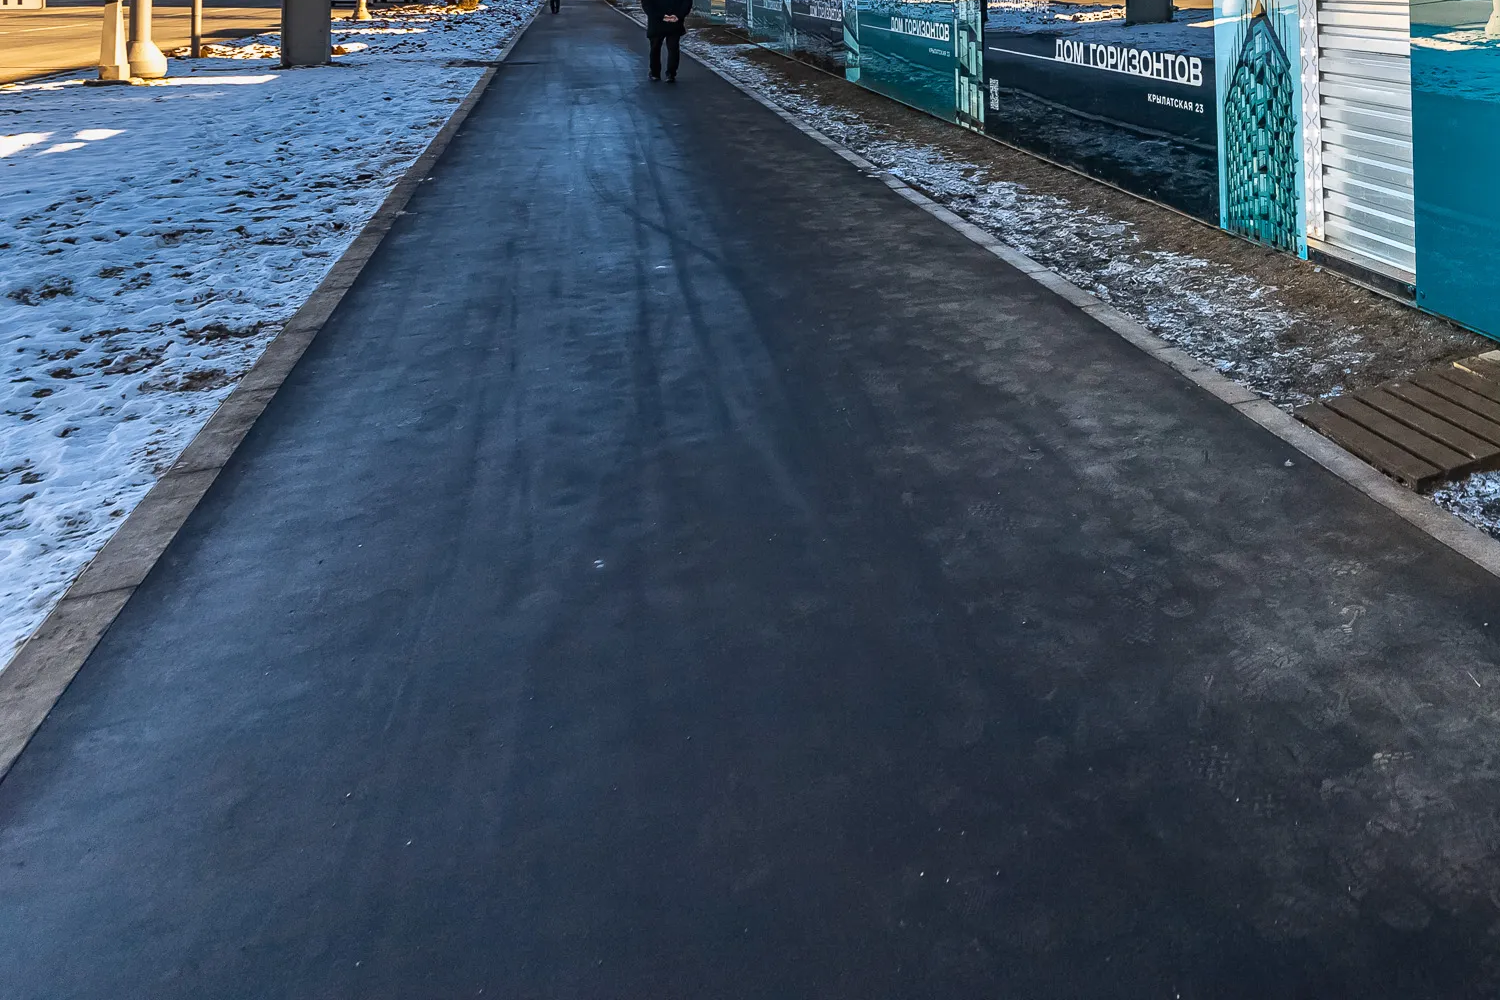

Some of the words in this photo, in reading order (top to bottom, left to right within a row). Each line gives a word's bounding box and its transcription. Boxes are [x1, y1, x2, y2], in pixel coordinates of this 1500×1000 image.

[890, 17, 903, 32] ДОМ
[905, 19, 950, 41] ГОРИЗОНТОВ
[1055, 39, 1084, 65] ДОМ
[1089, 43, 1203, 86] ГОРИЗОНТОВ
[1147, 93, 1194, 111] КРЫЛАТСКАЯ
[1195, 103, 1204, 114] 23
